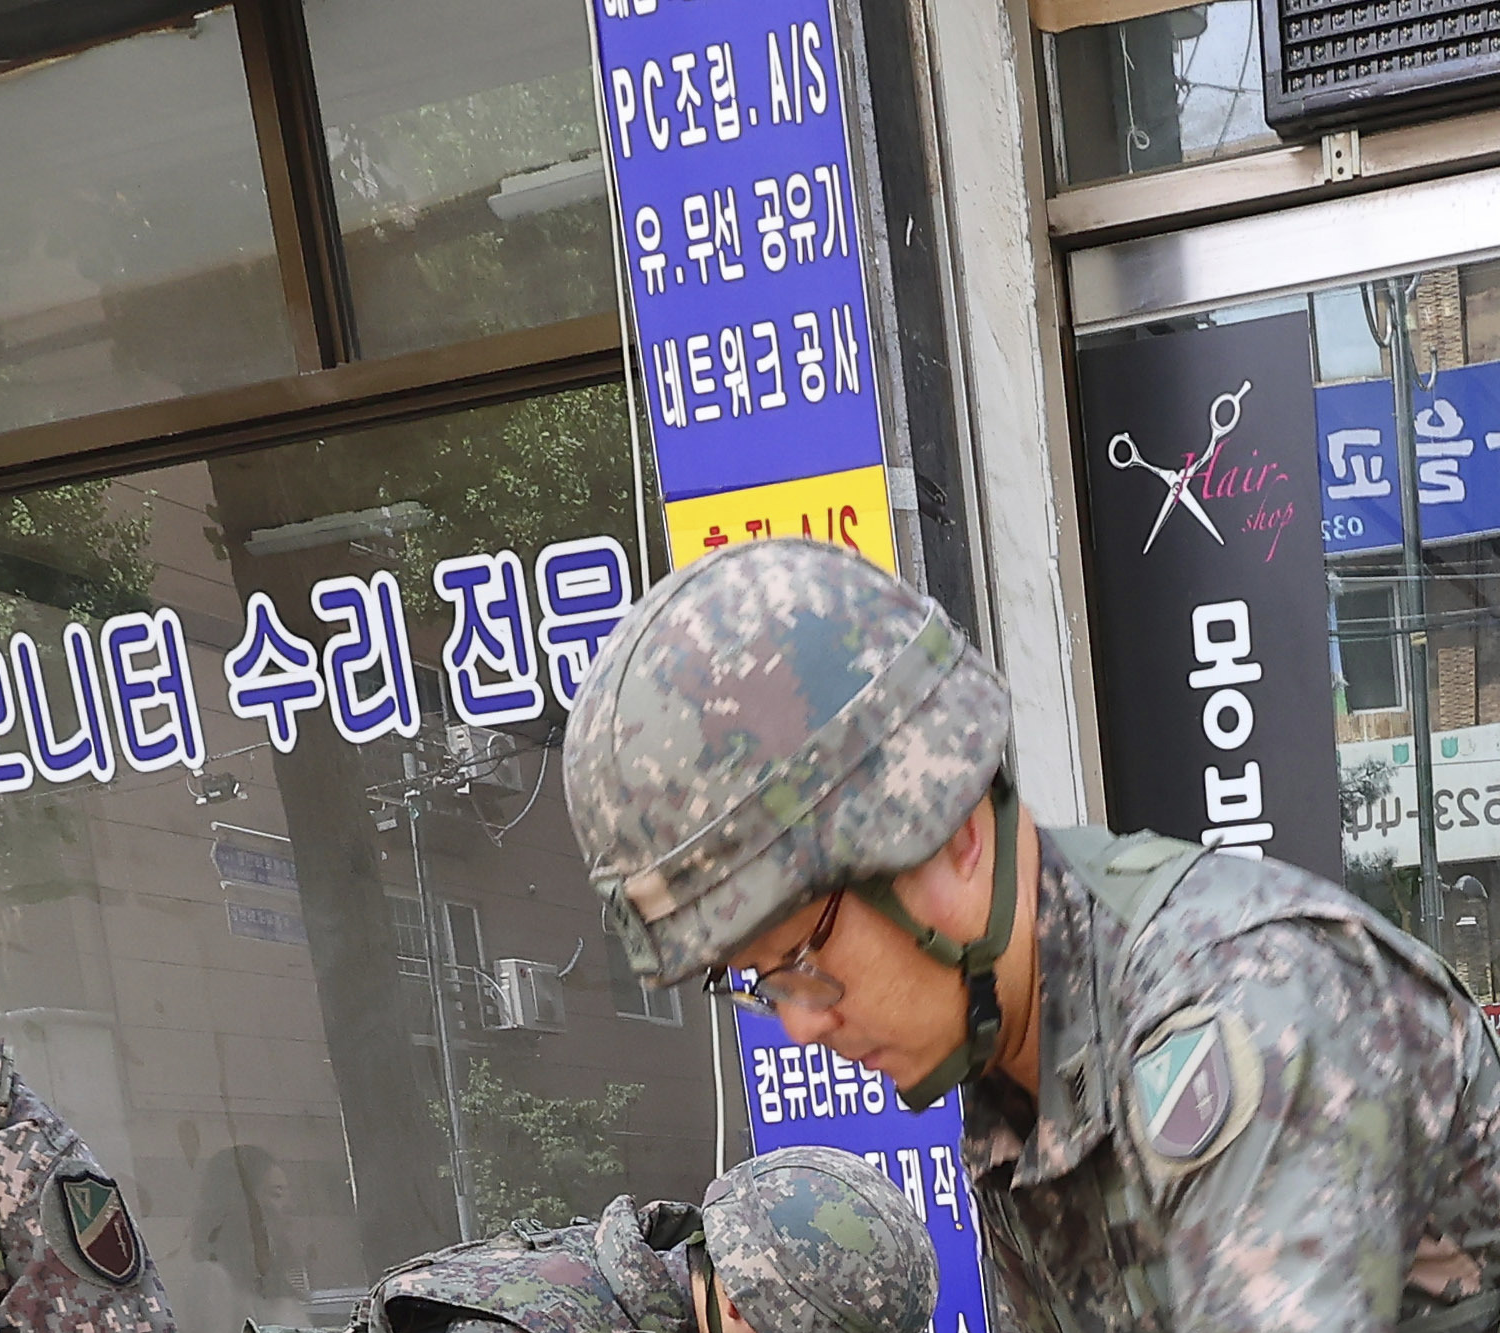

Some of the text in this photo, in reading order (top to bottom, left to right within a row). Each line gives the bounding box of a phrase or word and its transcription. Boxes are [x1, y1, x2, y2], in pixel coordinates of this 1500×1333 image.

[768, 20, 828, 127] A/S
[634, 163, 850, 296] 유.무선 공유기
[653, 303, 861, 430] 네트워크 공사
[1174, 438, 1290, 506] Hair
[1240, 497, 1295, 563] shop
[224, 570, 421, 754] 수리
